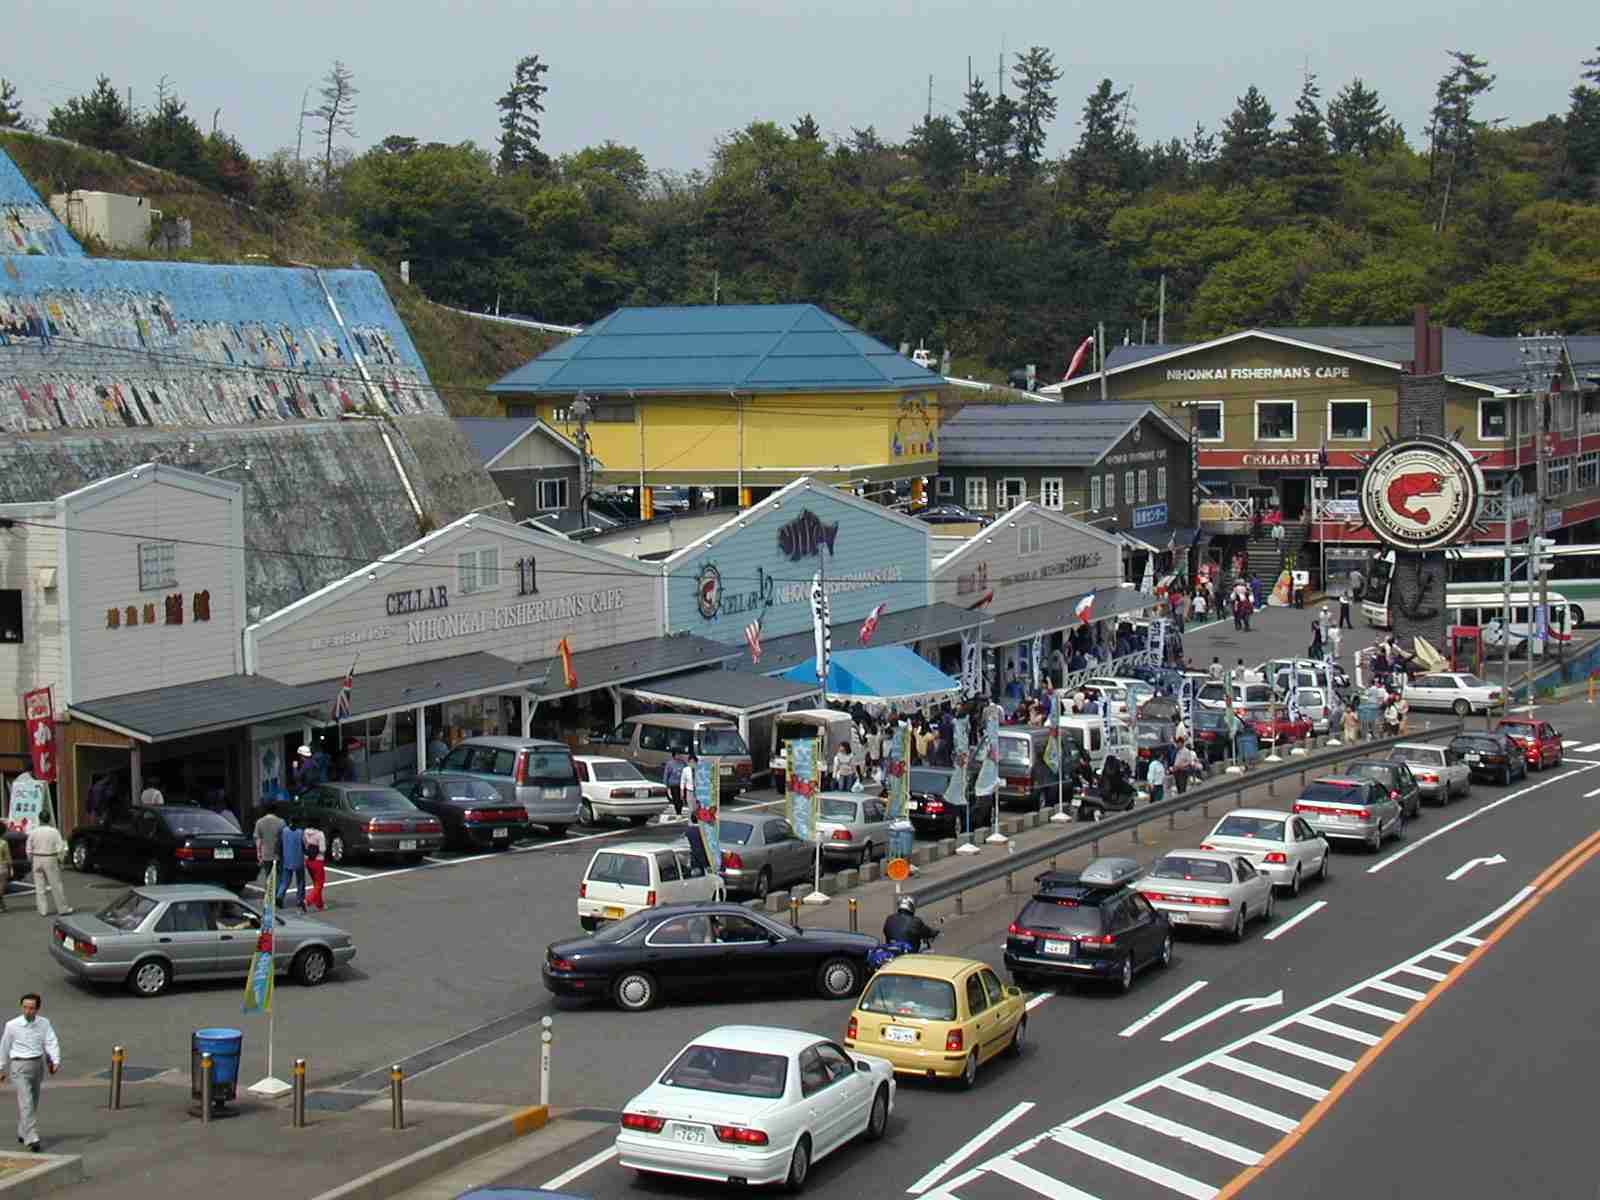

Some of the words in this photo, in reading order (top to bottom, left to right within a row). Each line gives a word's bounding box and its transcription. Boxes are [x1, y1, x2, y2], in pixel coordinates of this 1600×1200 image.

[1166, 367, 1227, 381] NIHONKAI
[1231, 366, 1312, 380] FISHERMAN'S
[1315, 366, 1351, 379] CAPE
[1242, 453, 1300, 466] CELLAR
[386, 585, 448, 616] CELLAR
[514, 556, 538, 596] 11
[407, 610, 488, 645] NIHONKAI
[591, 587, 624, 614] CAPE
[722, 591, 758, 616] CELLAR
